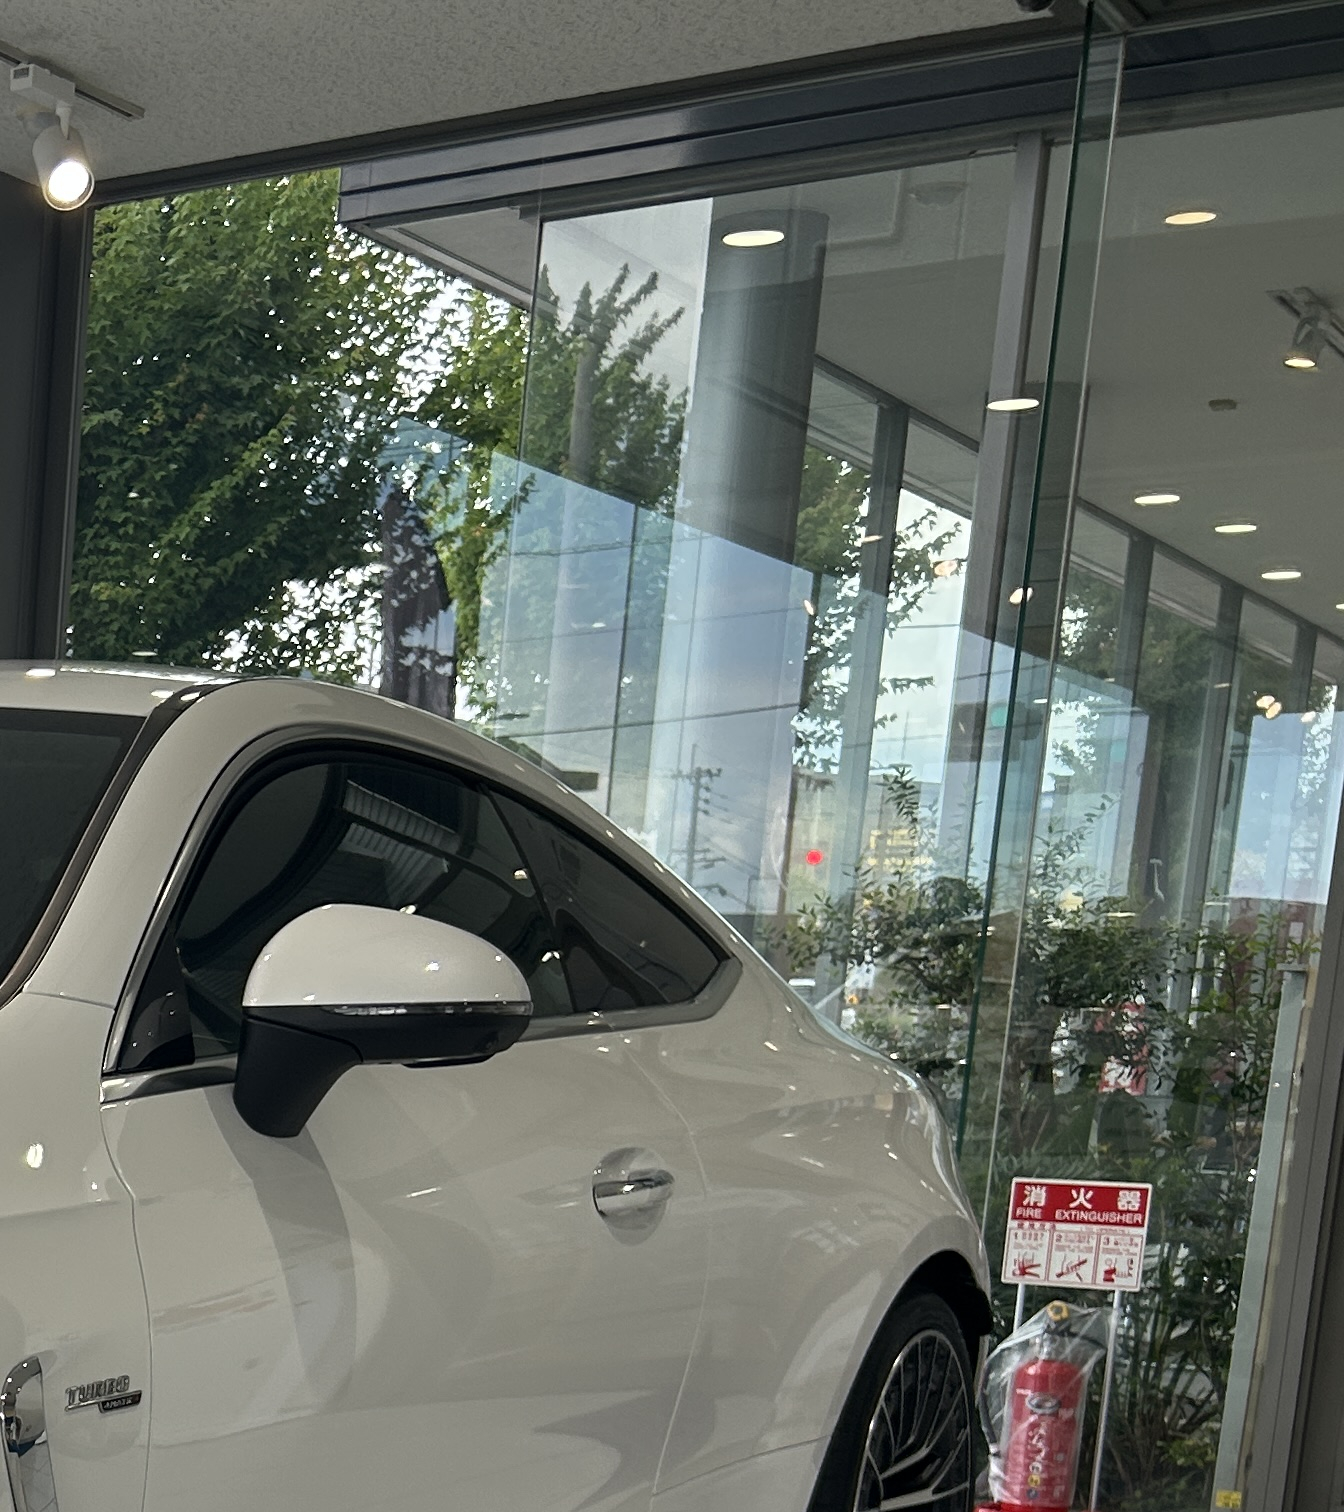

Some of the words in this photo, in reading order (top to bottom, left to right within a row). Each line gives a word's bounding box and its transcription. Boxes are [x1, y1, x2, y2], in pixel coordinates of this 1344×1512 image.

[1023, 1184, 1141, 1212] 消火器
[1015, 1206, 1043, 1219] FIRE
[1054, 1208, 1143, 1225] EXTINGUISHER
[65, 1374, 130, 1406] TURBO
